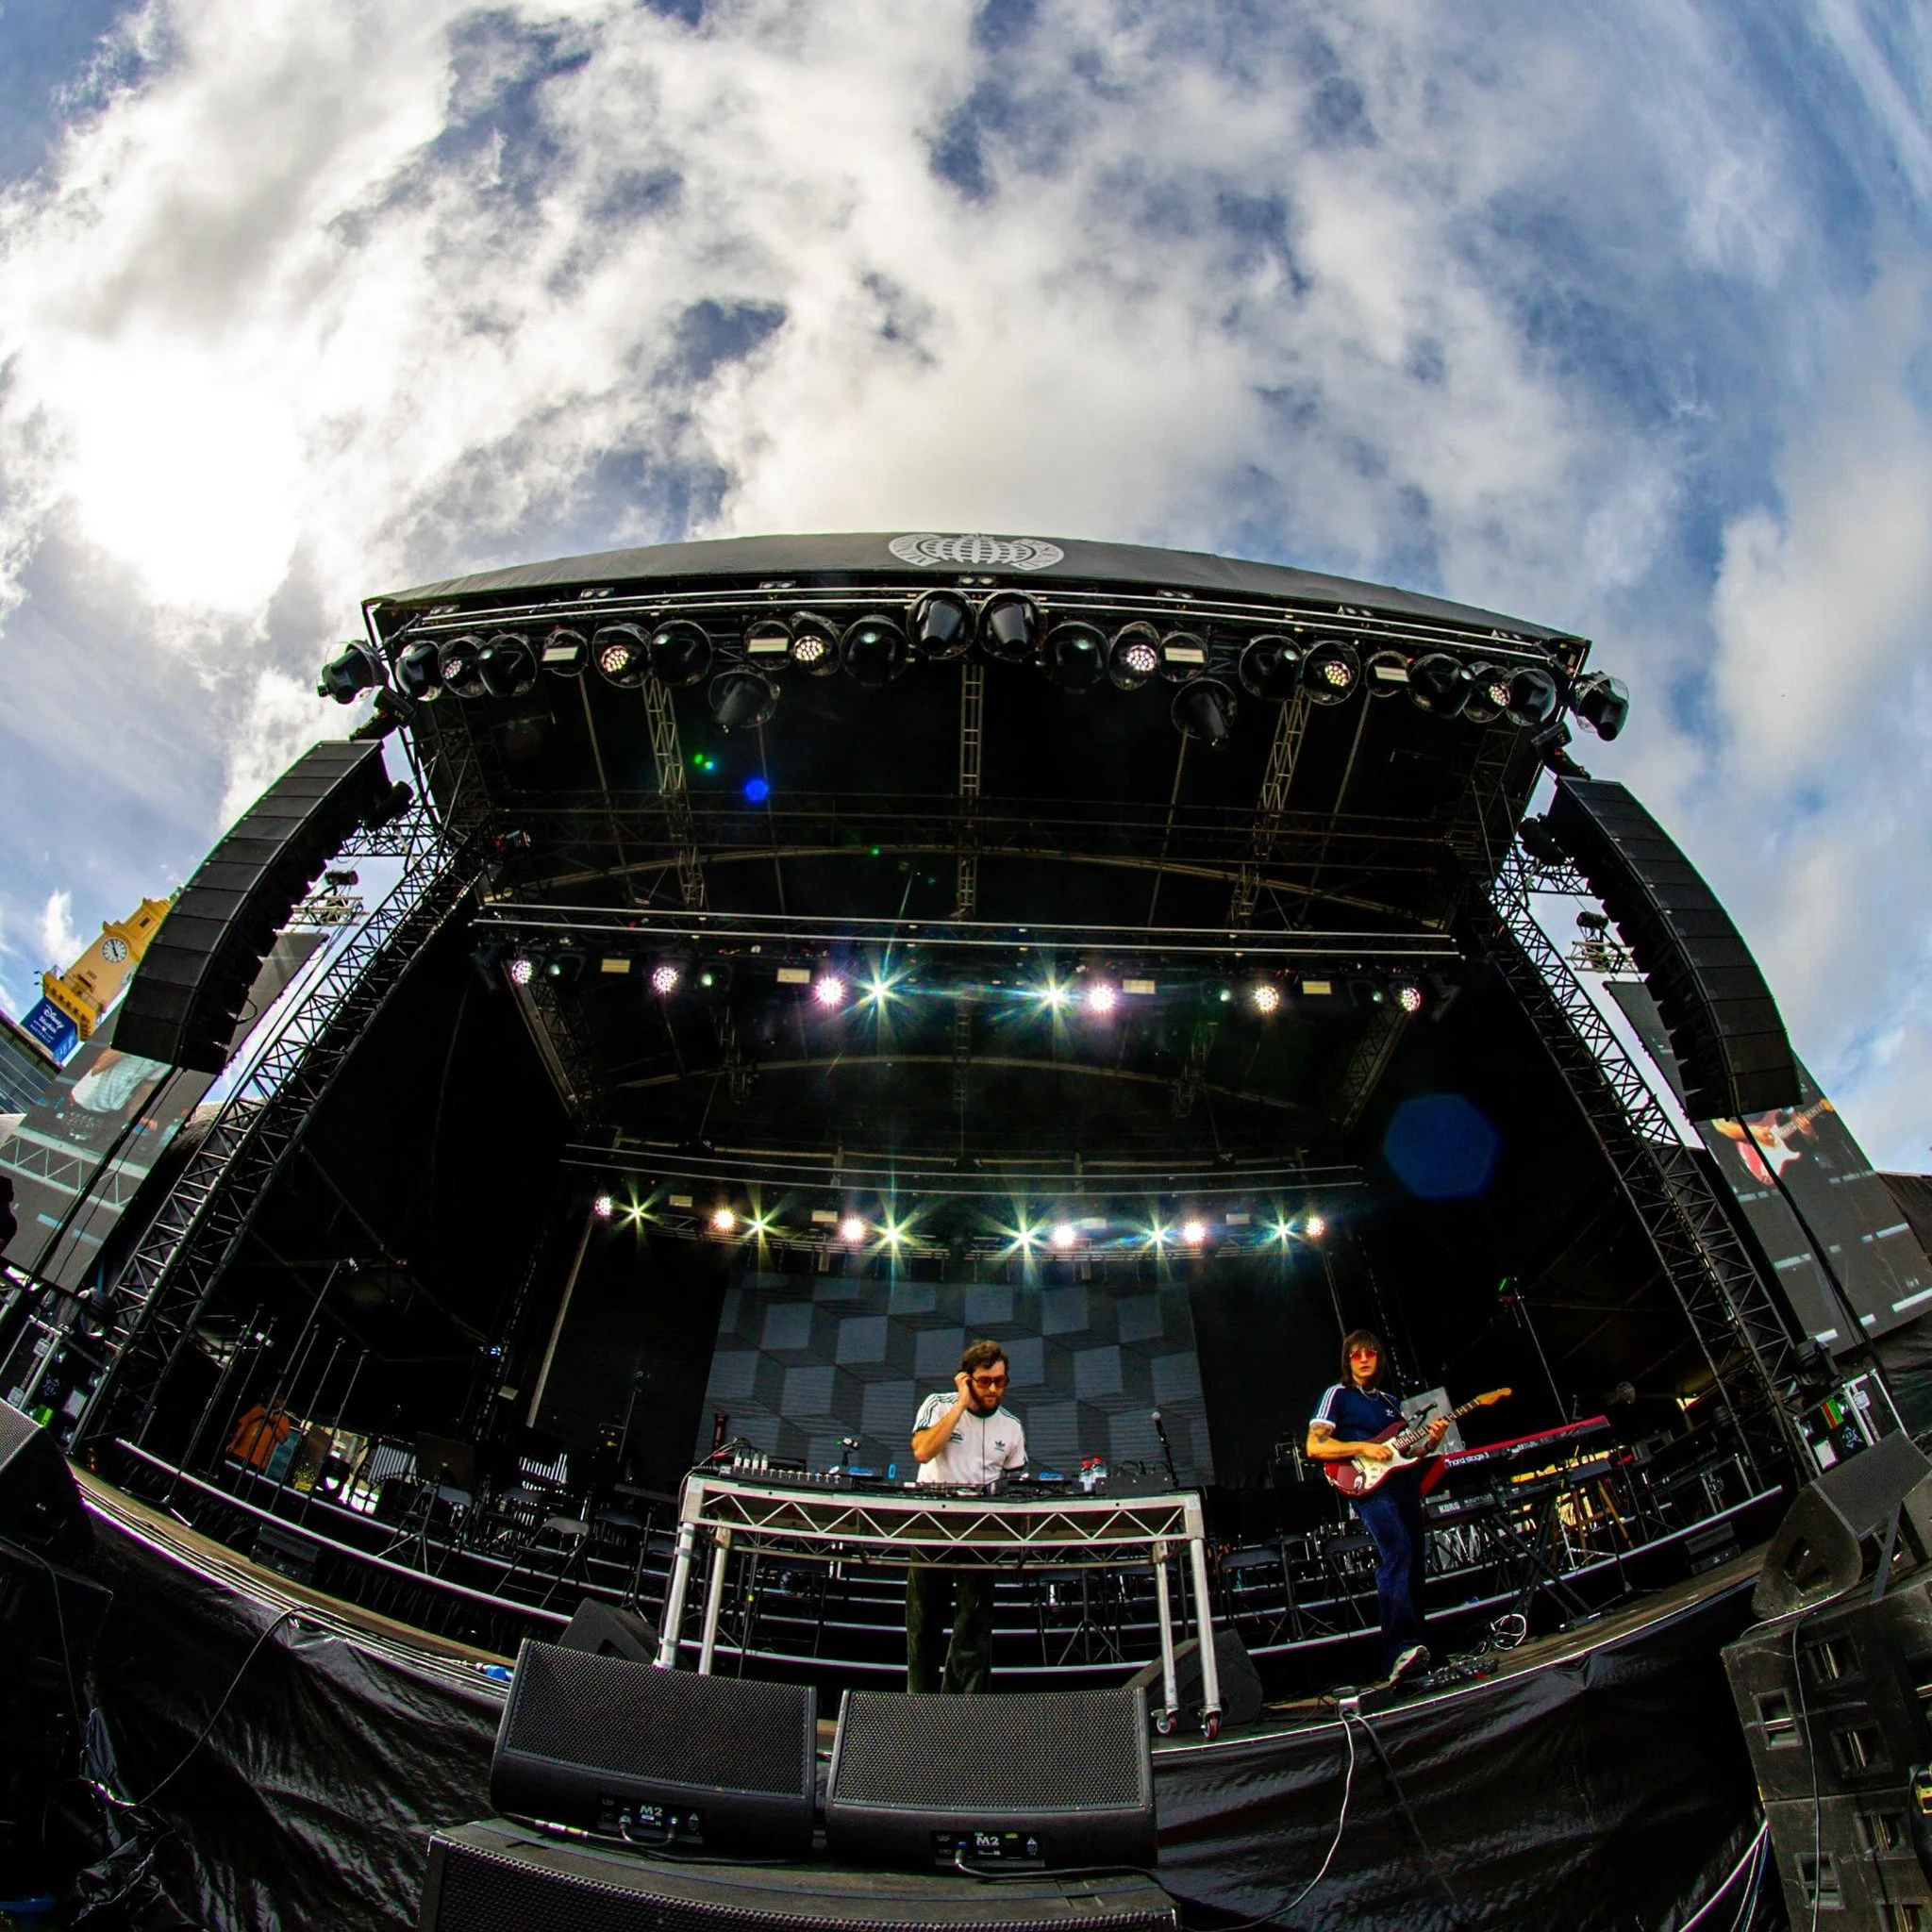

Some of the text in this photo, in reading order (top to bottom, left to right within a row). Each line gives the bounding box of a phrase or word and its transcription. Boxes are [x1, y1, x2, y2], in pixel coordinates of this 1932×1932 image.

[43, 1004, 65, 1029] Disney
[1438, 1501, 1460, 1513] KORG
[640, 1805, 663, 1817] M2
[975, 1836, 1000, 1846] M2
